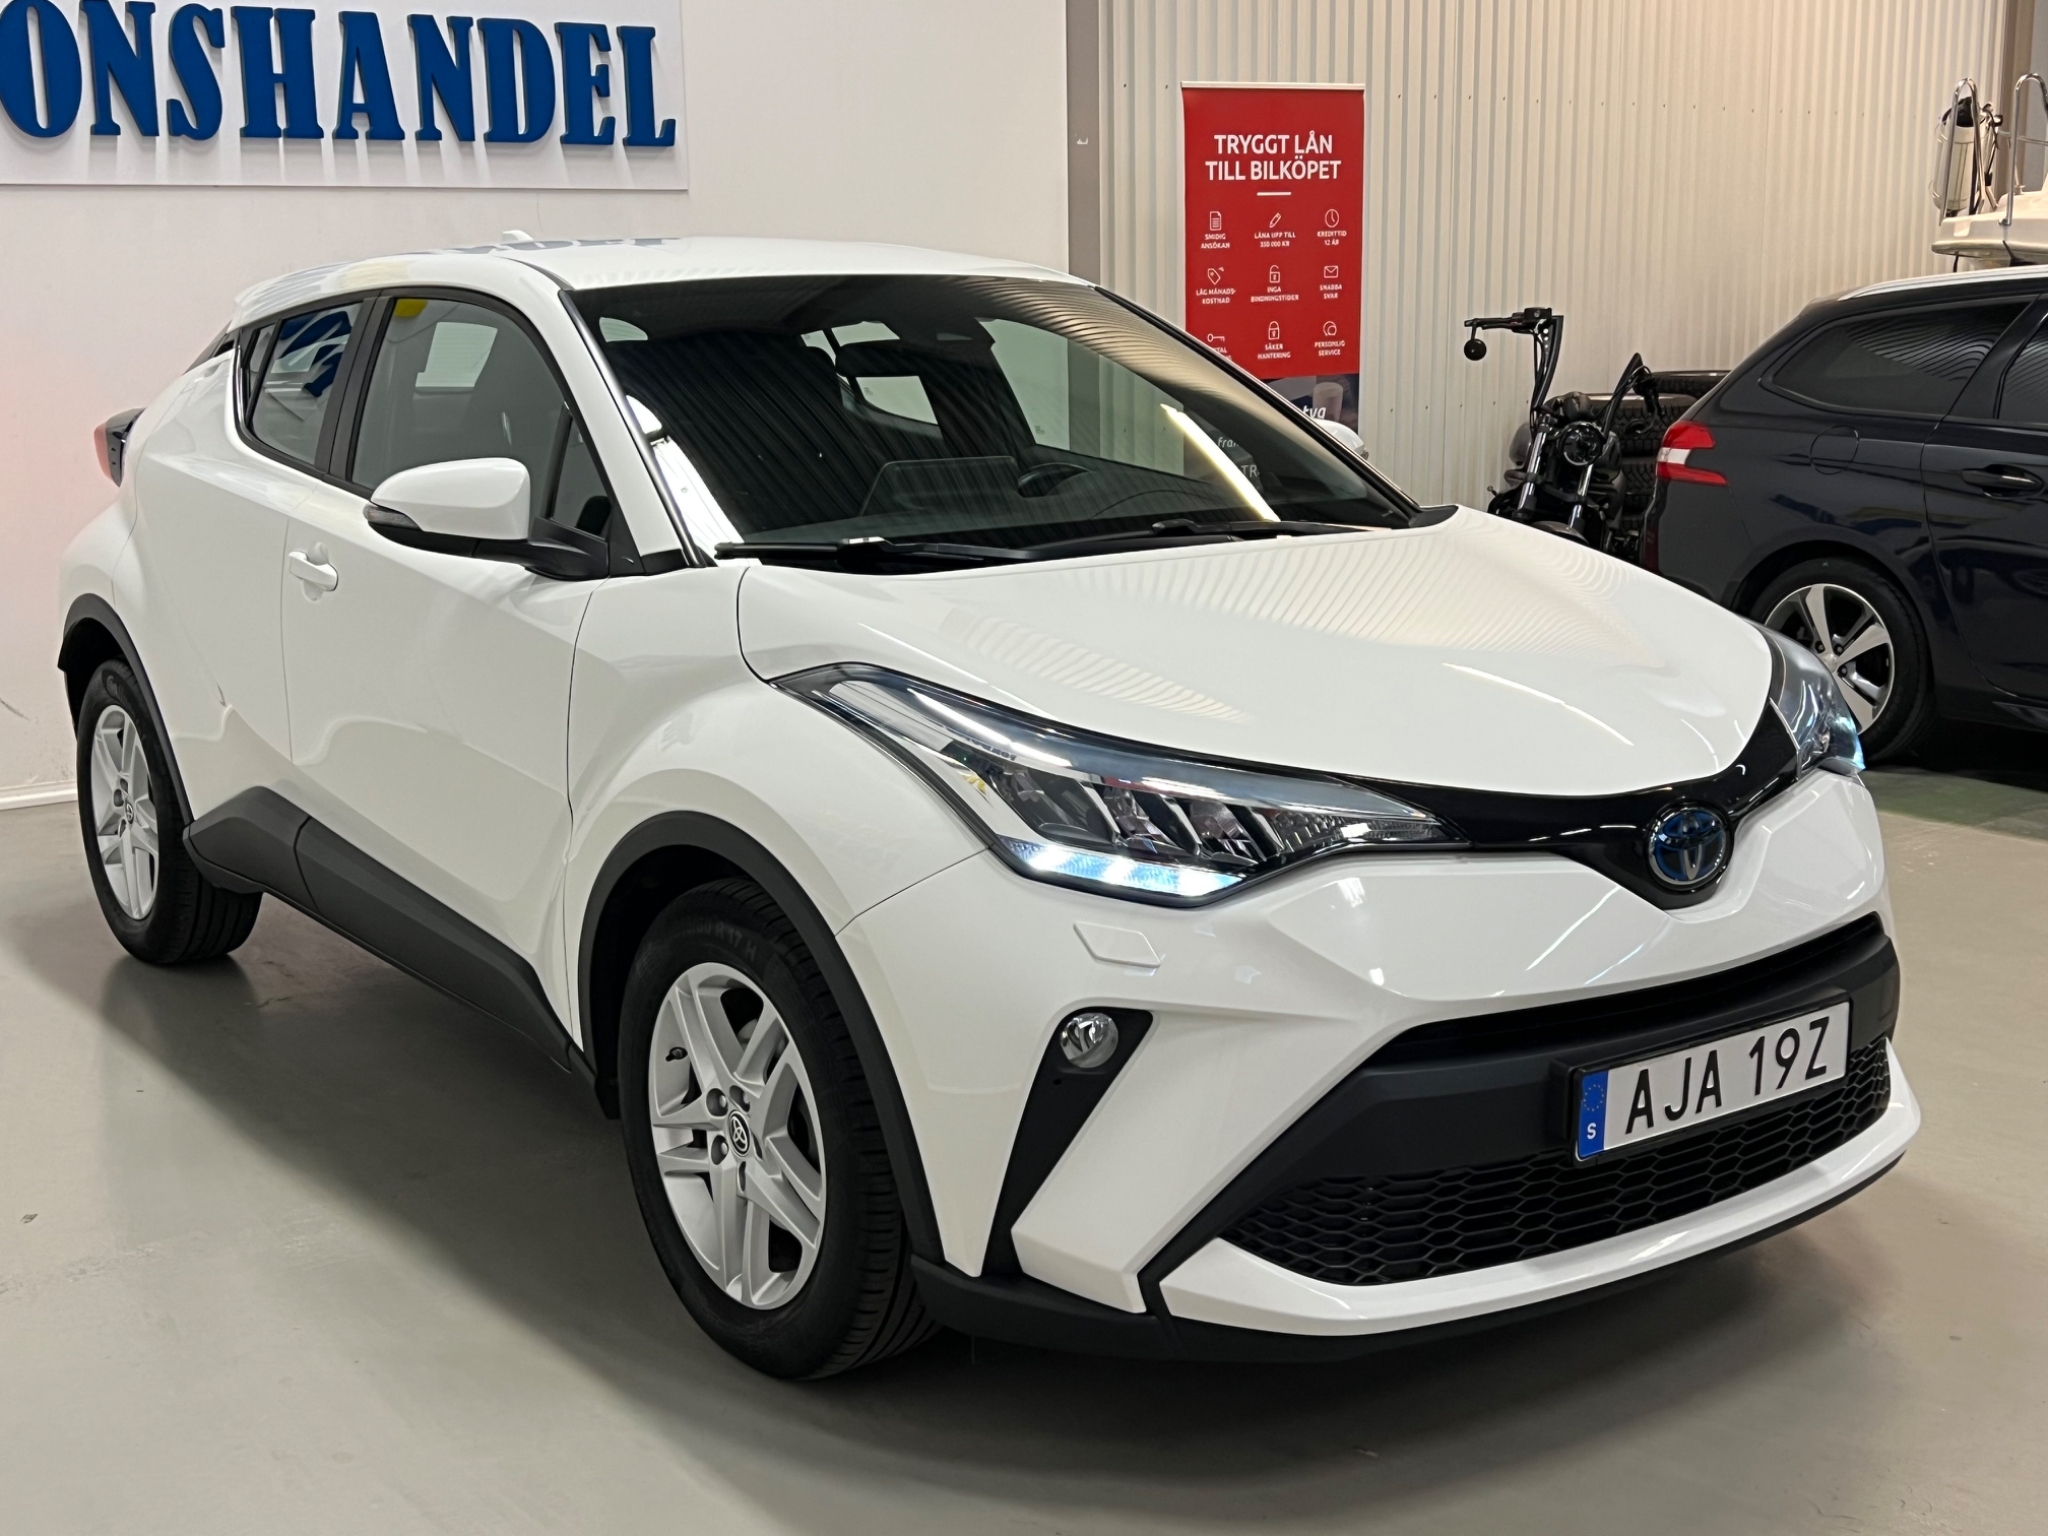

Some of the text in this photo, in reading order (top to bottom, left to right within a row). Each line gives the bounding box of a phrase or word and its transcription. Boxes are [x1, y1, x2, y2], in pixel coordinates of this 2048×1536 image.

[0, 0, 676, 148] ONSHANDEL
[1213, 130, 1333, 154] TRYGGT LÅN
[1205, 155, 1342, 181] TILL BILKÖPET
[1204, 232, 1227, 240] SMIDIG
[1254, 231, 1296, 240] LÅNA UPP TILL
[1316, 230, 1347, 238] KREDITTID
[1200, 241, 1231, 249] ANSÖKAN
[1271, 240, 1281, 248] 000
[1195, 287, 1208, 296] LÅG
[1323, 292, 1339, 300] SVAR
[1201, 296, 1231, 305] KOSTNAD
[1264, 343, 1284, 351] SÄKER
[1314, 340, 1346, 348] PERSONLIG
[1257, 351, 1291, 360] HANTERING
[1318, 348, 1341, 356] SERVICE
[1587, 1015, 1831, 1140] S AJA 19Z
